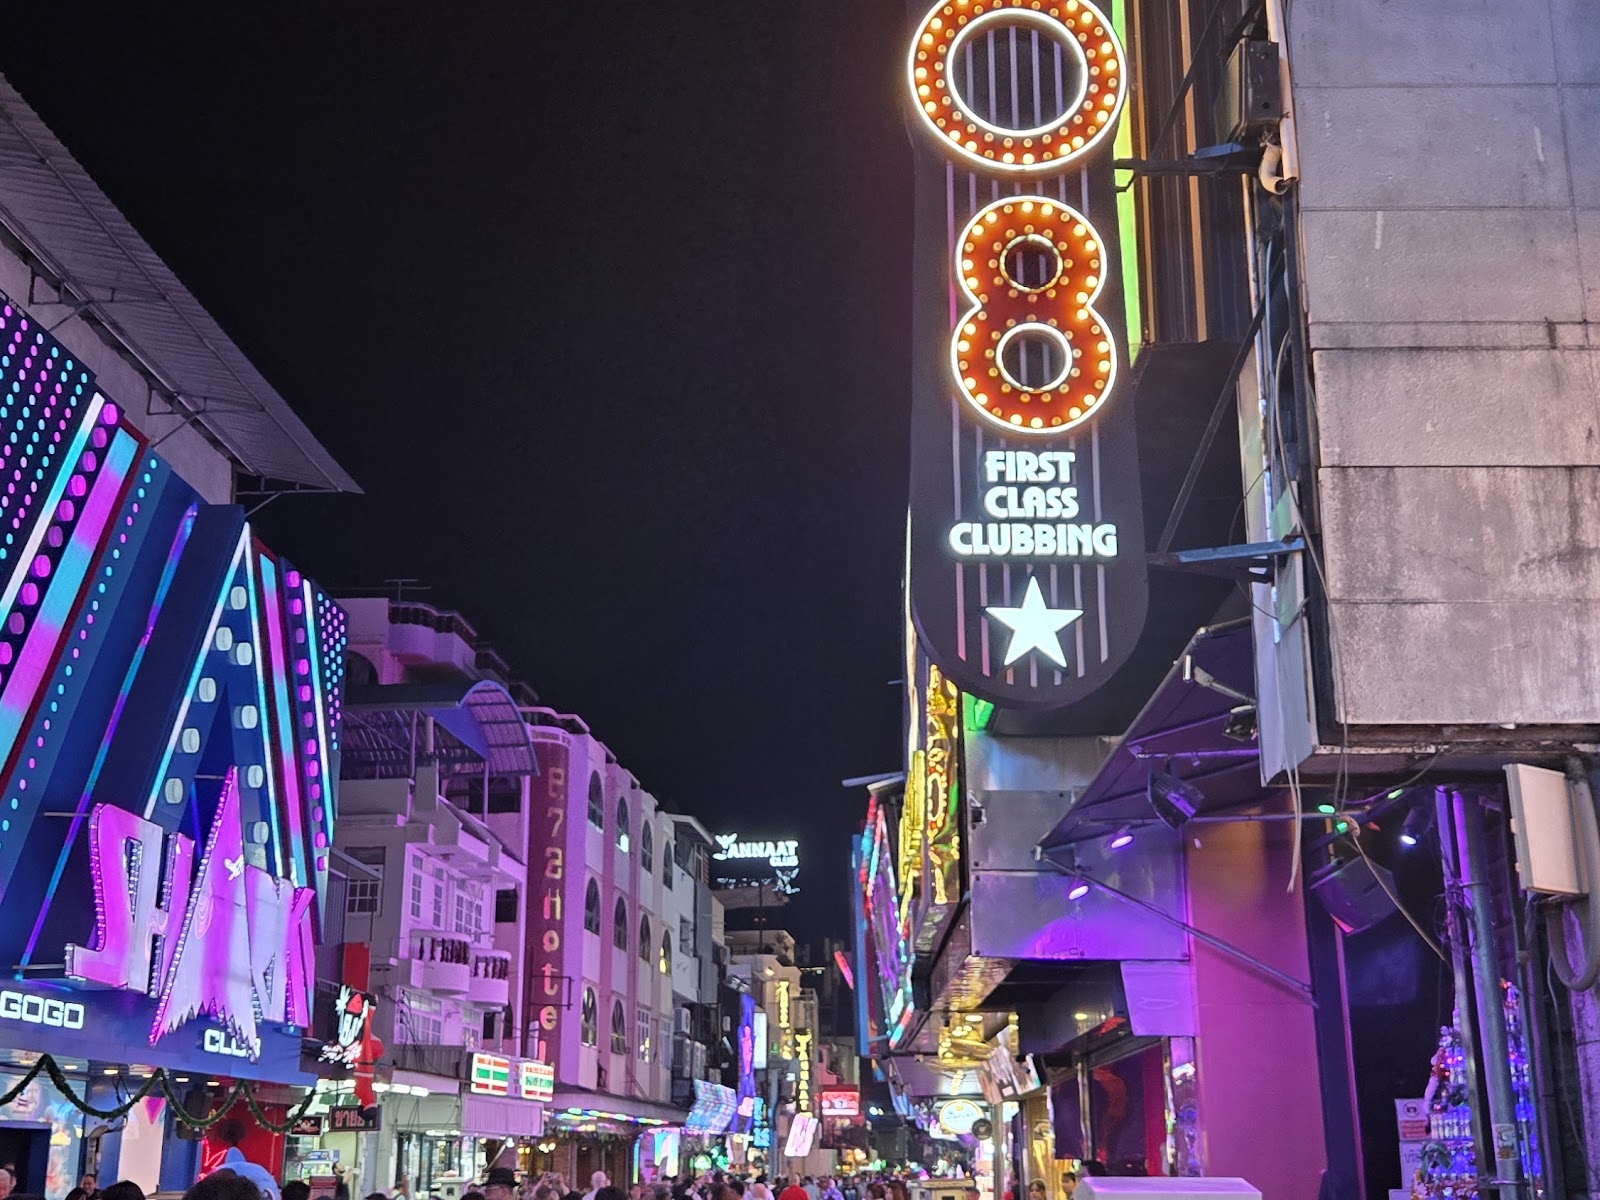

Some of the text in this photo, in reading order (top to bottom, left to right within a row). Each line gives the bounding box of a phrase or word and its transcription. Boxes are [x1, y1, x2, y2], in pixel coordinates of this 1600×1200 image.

[985, 450, 1076, 484] FIRST
[983, 485, 1080, 520] CLASS
[948, 521, 1119, 558] CLUBBING
[0, 990, 85, 1030] GOGO
